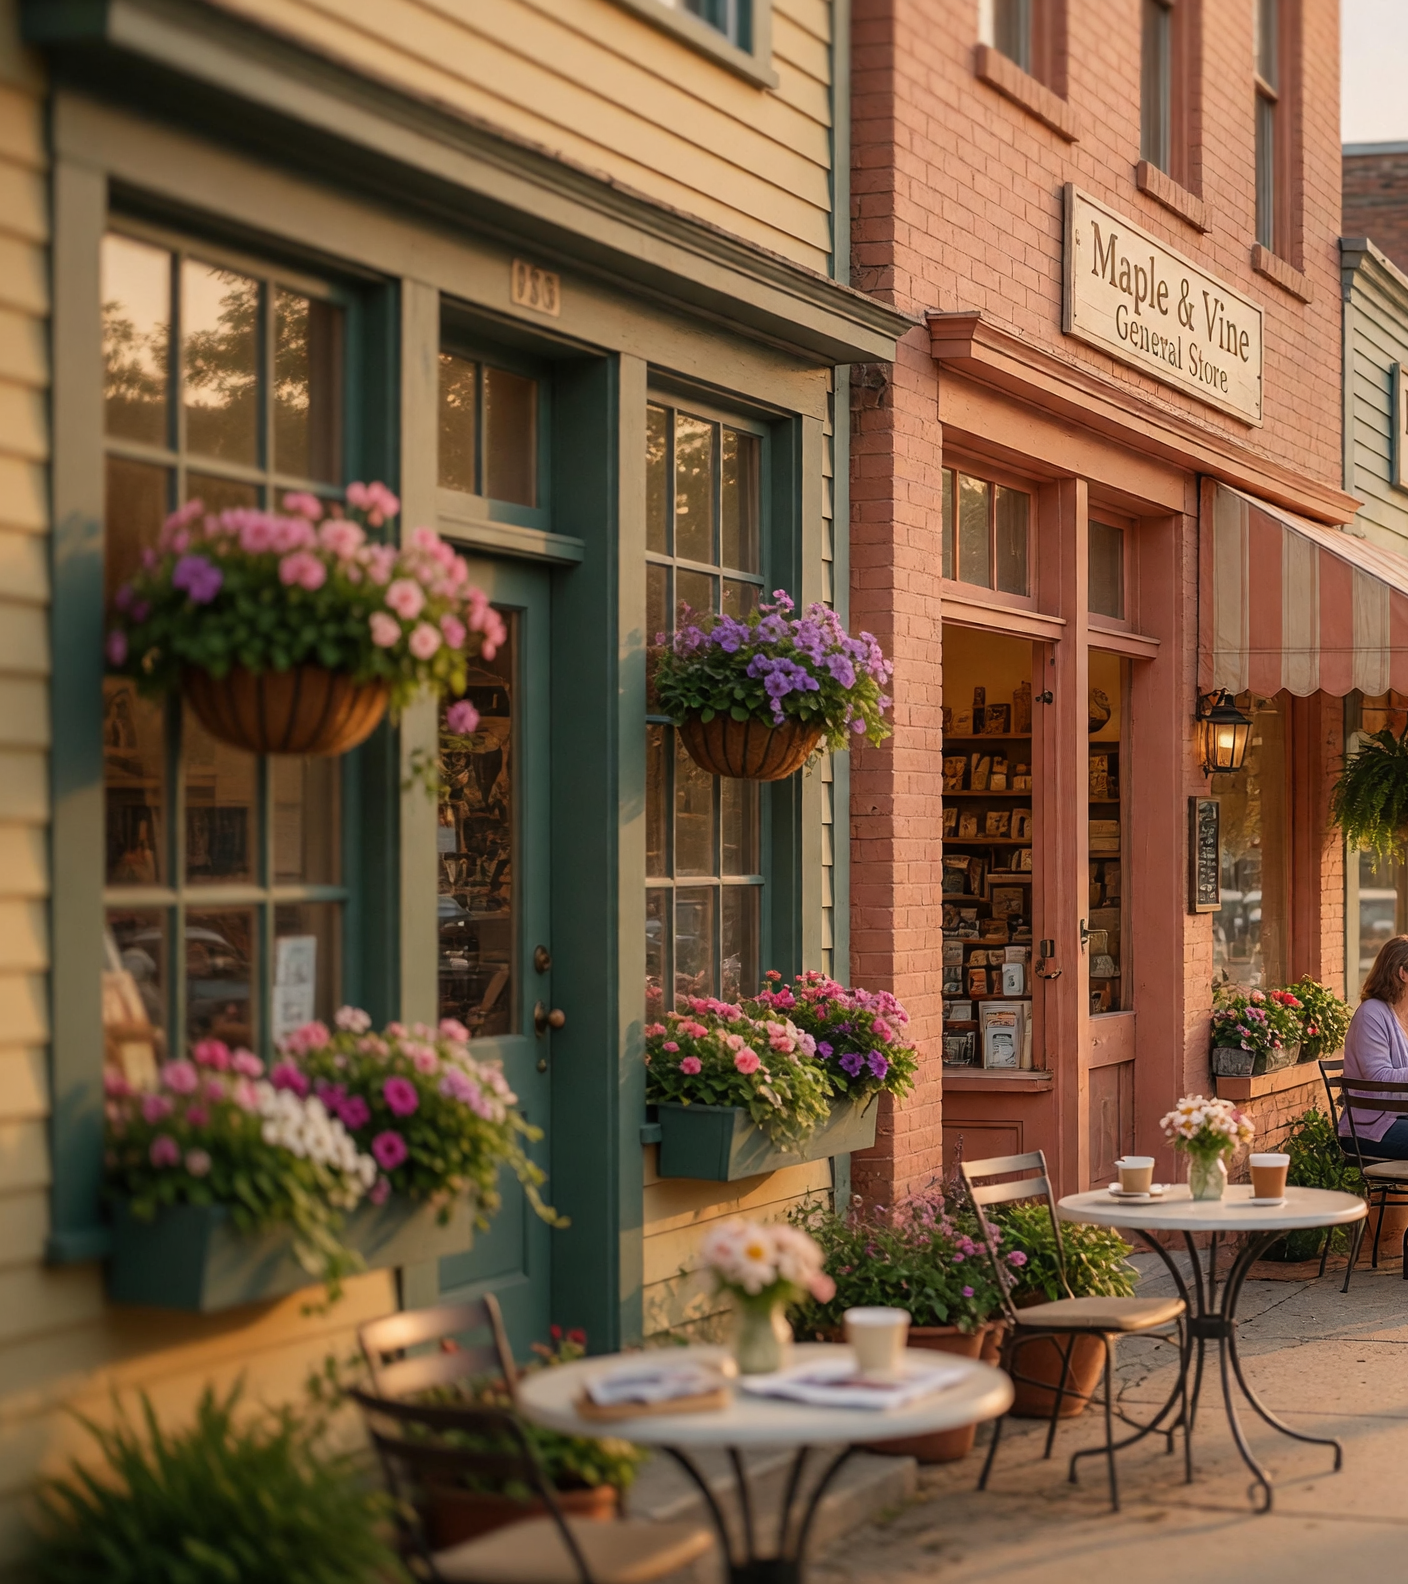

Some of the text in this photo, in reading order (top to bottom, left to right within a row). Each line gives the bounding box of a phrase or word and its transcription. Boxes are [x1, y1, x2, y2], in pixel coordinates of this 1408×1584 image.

[1091, 221, 1250, 363] Maple & Vine
[1115, 304, 1229, 394] General Store
